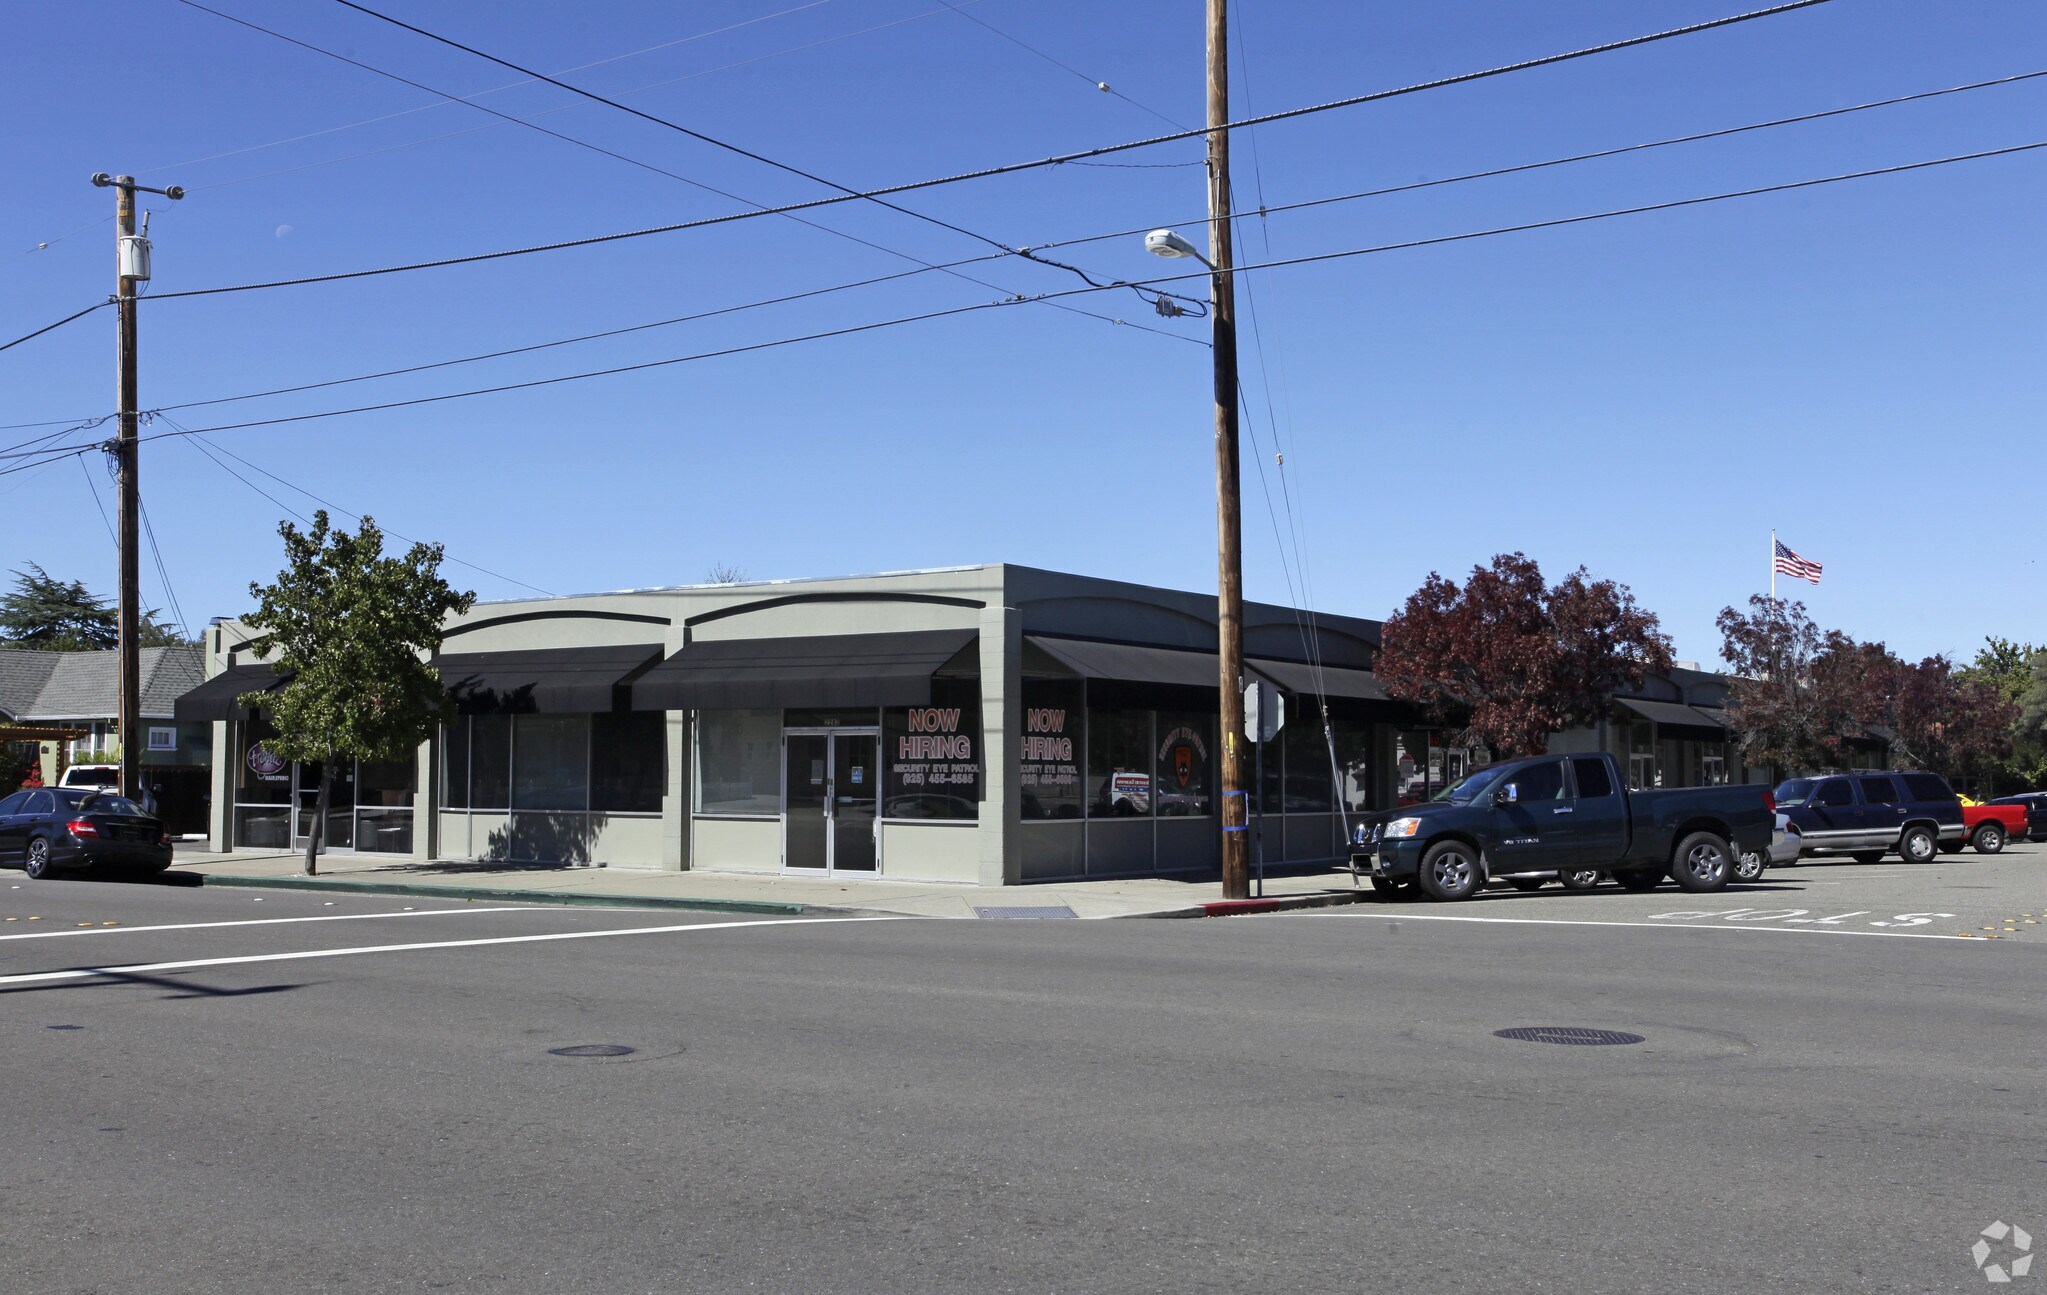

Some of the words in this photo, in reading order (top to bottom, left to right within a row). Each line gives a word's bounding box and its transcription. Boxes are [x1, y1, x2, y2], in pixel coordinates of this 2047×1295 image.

[909, 708, 960, 732] NOW
[1028, 709, 1065, 732] NOW
[900, 735, 971, 759] HIRING
[1021, 736, 1072, 761] HIRING
[893, 764, 930, 772] SECURITY
[932, 764, 949, 773] EYE
[951, 764, 980, 773] PATROL
[1648, 908, 1956, 927] STOP
